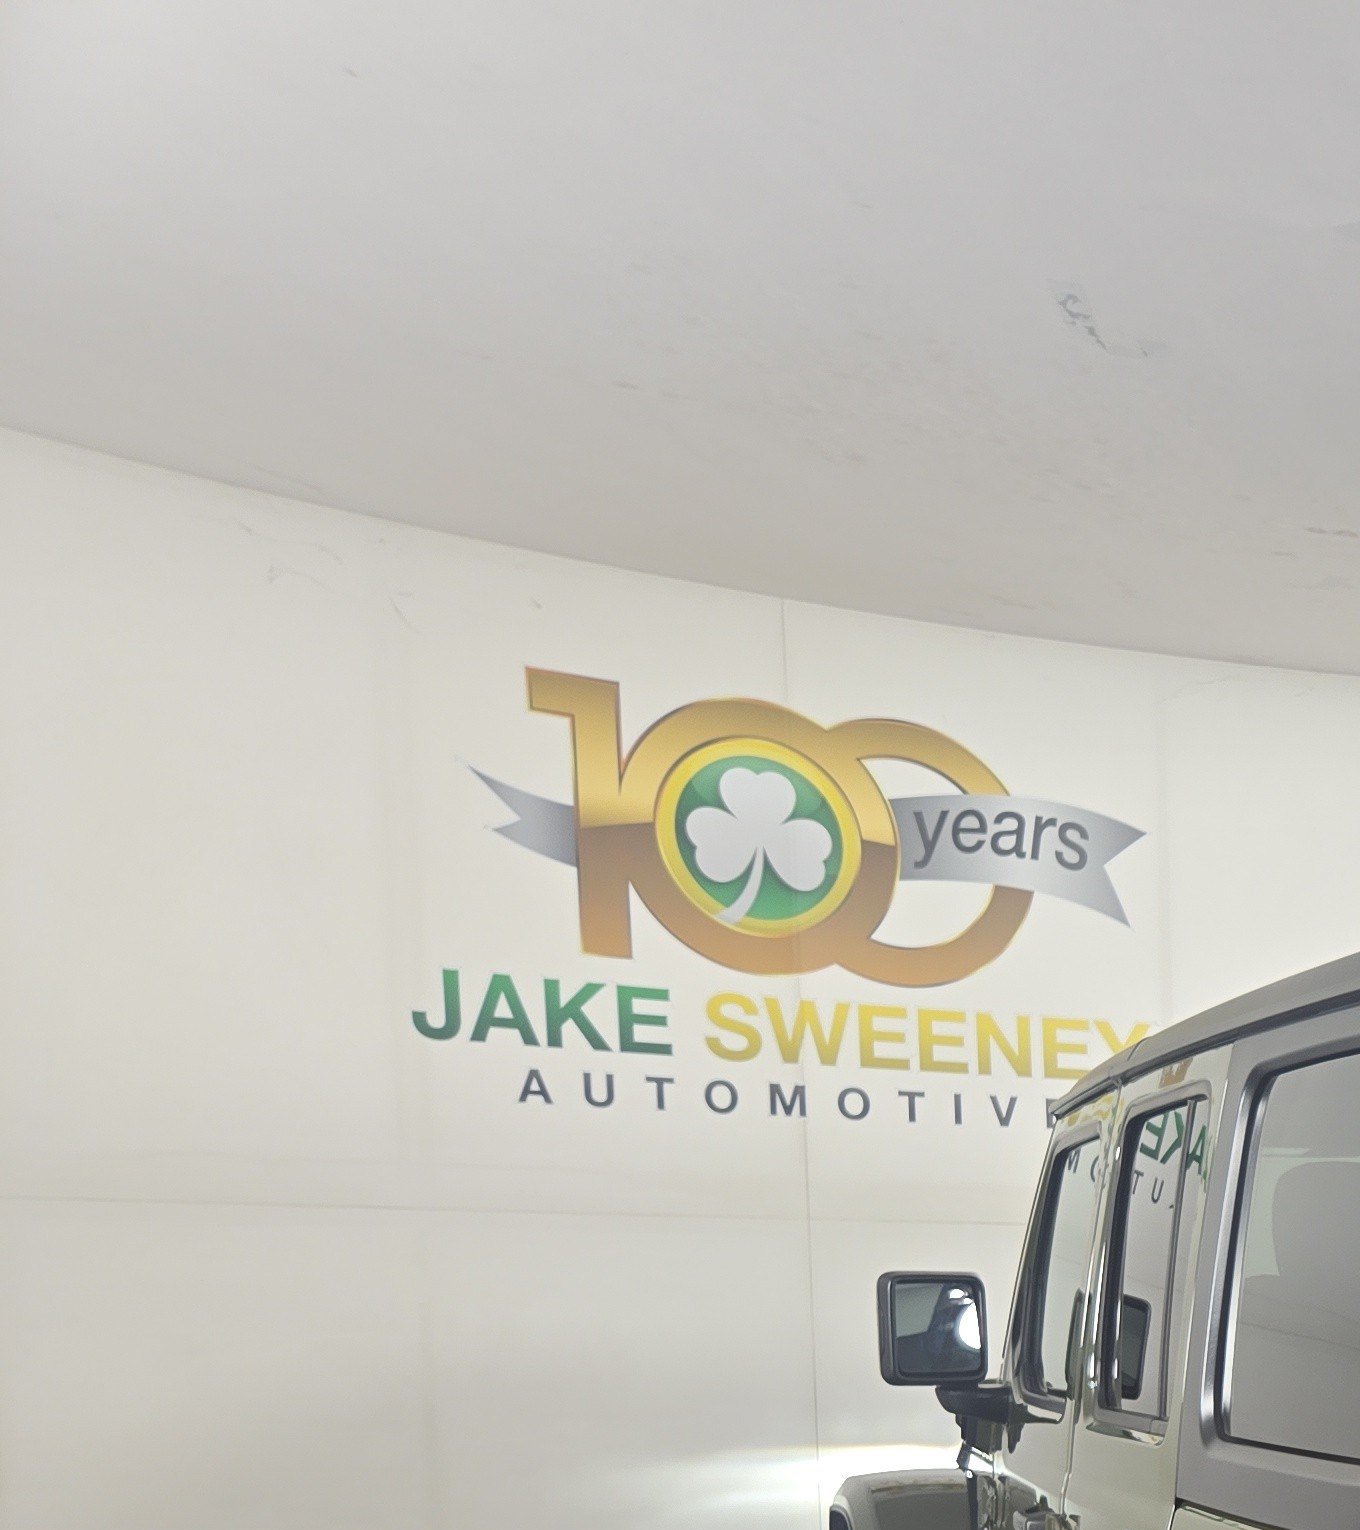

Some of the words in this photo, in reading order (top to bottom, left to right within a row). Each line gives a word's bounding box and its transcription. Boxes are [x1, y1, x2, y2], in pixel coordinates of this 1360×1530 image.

[912, 803, 1091, 872] years
[411, 968, 673, 1057] JAKE
[704, 992, 1150, 1080] SWEENEY
